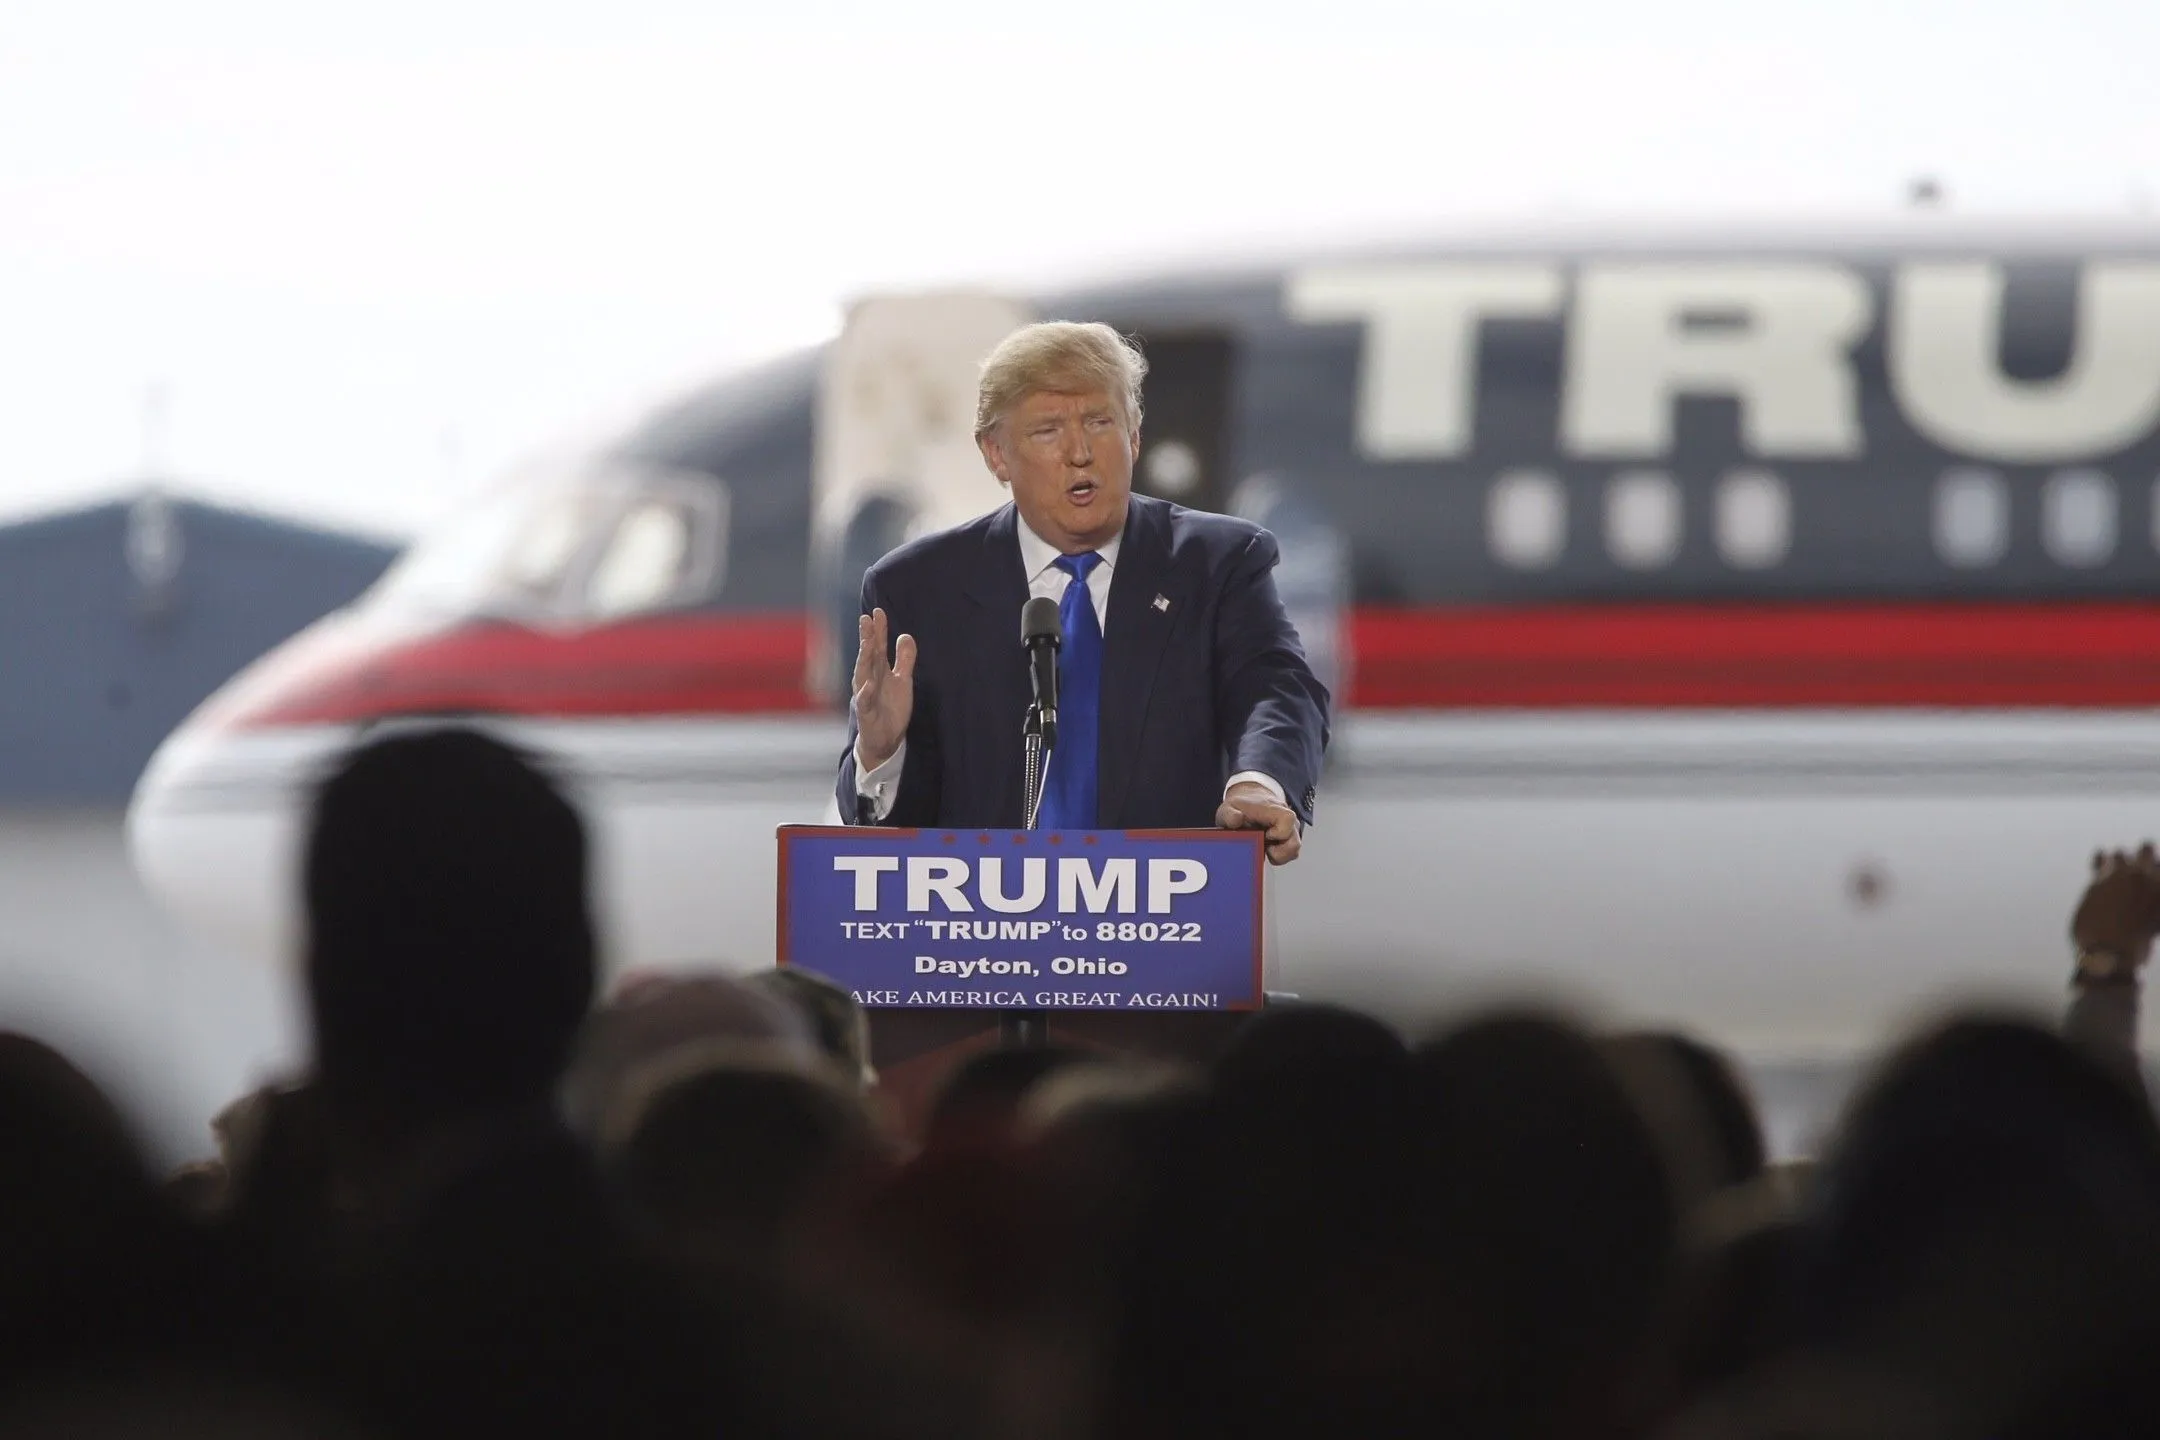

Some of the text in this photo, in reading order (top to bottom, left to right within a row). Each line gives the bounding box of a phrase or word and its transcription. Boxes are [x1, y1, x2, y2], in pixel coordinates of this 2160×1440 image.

[833, 856, 1208, 914] TRUMP
[840, 921, 911, 940] TEXT
[1062, 924, 1088, 941] to
[1095, 921, 1202, 942] 88022
[914, 956, 1128, 978] Dayton, Ohio
[851, 990, 1218, 1007] AKE AMERICA GREAT AGAIN!
